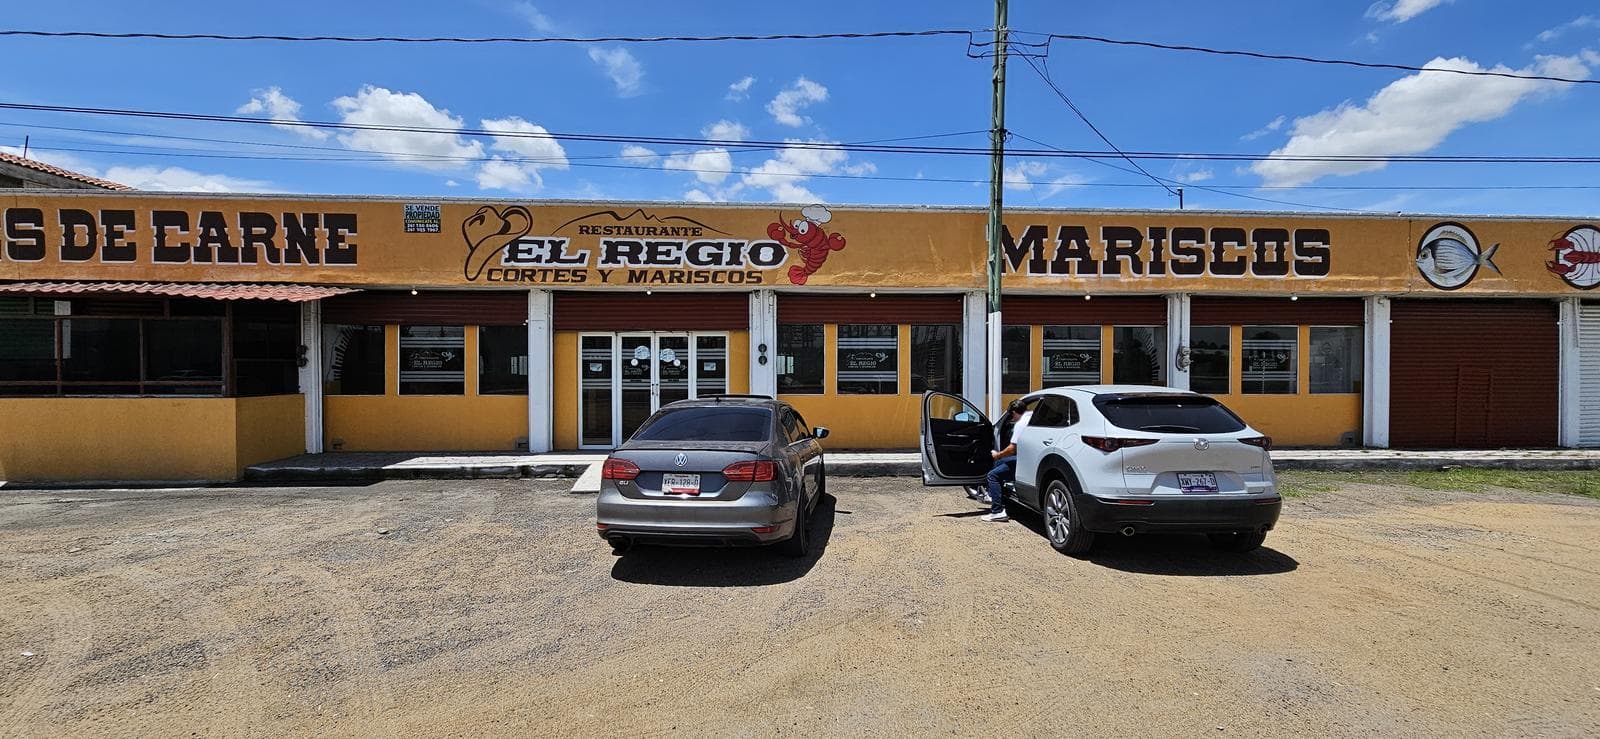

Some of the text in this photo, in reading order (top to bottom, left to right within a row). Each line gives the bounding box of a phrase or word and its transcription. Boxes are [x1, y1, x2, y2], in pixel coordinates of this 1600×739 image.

[405, 211, 440, 219] PROPIEDAD
[0, 207, 358, 266] S DE CARNE
[578, 225, 703, 236] RESTAURANTE
[502, 237, 789, 268] EL REGIO
[987, 224, 1331, 279] MARISCOS
[487, 269, 763, 284] CORTES Y MARISCOS
